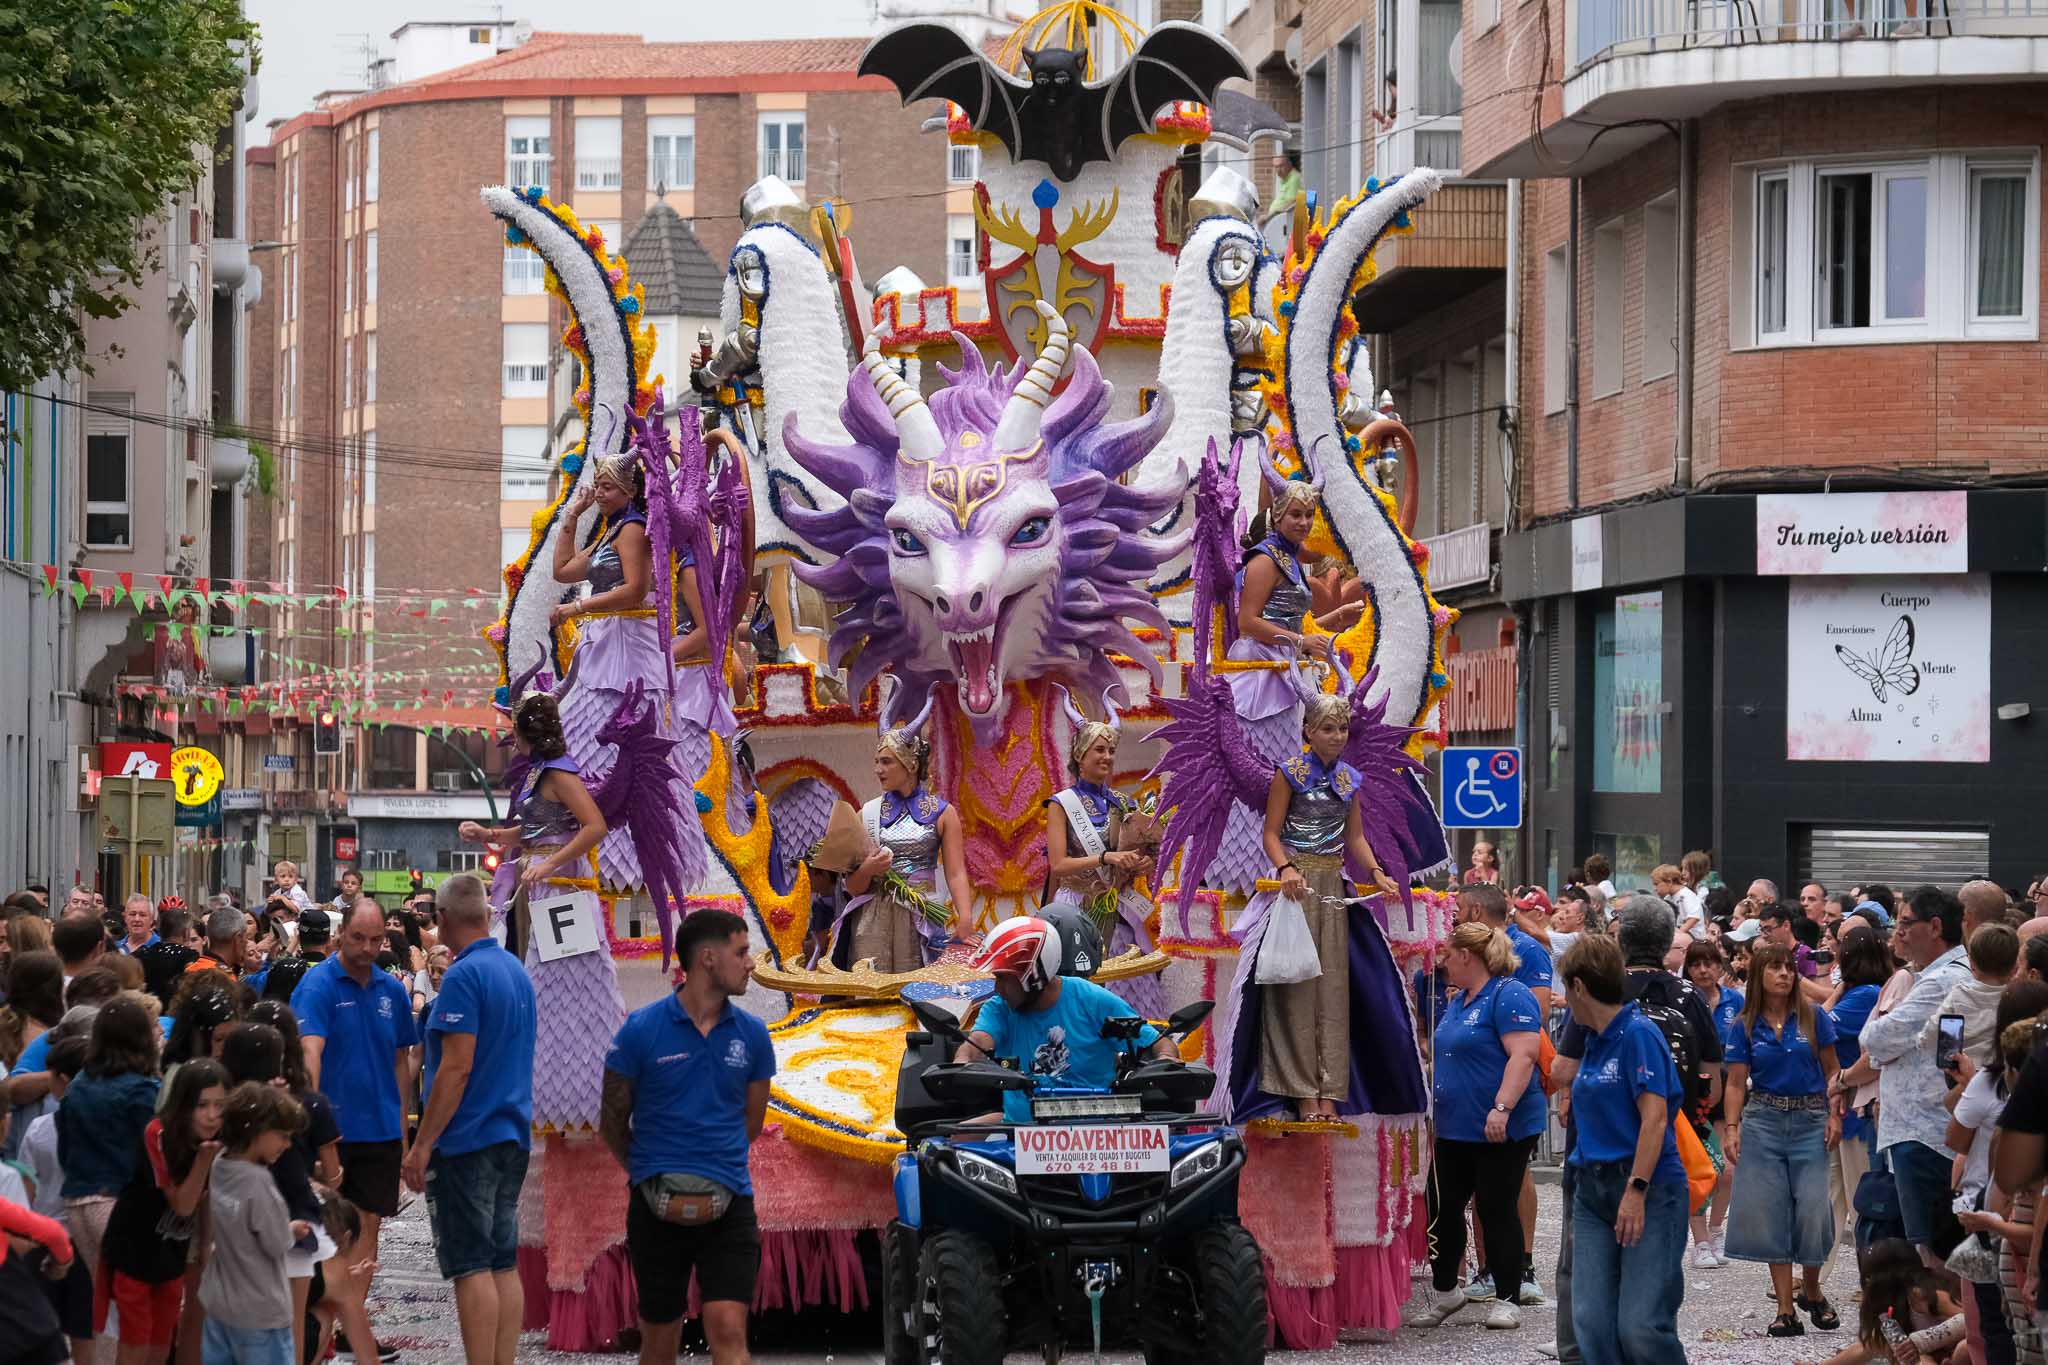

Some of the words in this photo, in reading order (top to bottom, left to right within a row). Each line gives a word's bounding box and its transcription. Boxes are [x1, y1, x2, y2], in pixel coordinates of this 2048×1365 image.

[1777, 524, 1805, 546] Tu
[1807, 525, 1867, 553] mejor
[1870, 523, 1949, 544] versión
[1881, 592, 1930, 611] Cuerpo
[1825, 624, 1876, 634] Emociones
[1921, 661, 1956, 674] Mente
[1848, 707, 1882, 722] Alma
[549, 904, 575, 944] F
[1018, 1128, 1166, 1152] VOTOAVENTURA
[1035, 1153, 1054, 1162] VENTA
[1056, 1153, 1060, 1161] Y
[1061, 1152, 1088, 1161] ALQUILER
[1090, 1152, 1097, 1161] DE
[1099, 1152, 1118, 1161] QUADS
[1120, 1152, 1124, 1160] Y
[1126, 1151, 1151, 1160] BUGGYES
[1045, 1163, 1072, 1172] 670
[1077, 1162, 1095, 1171] 42
[1100, 1162, 1118, 1171] 48
[1125, 1161, 1139, 1170] 81
